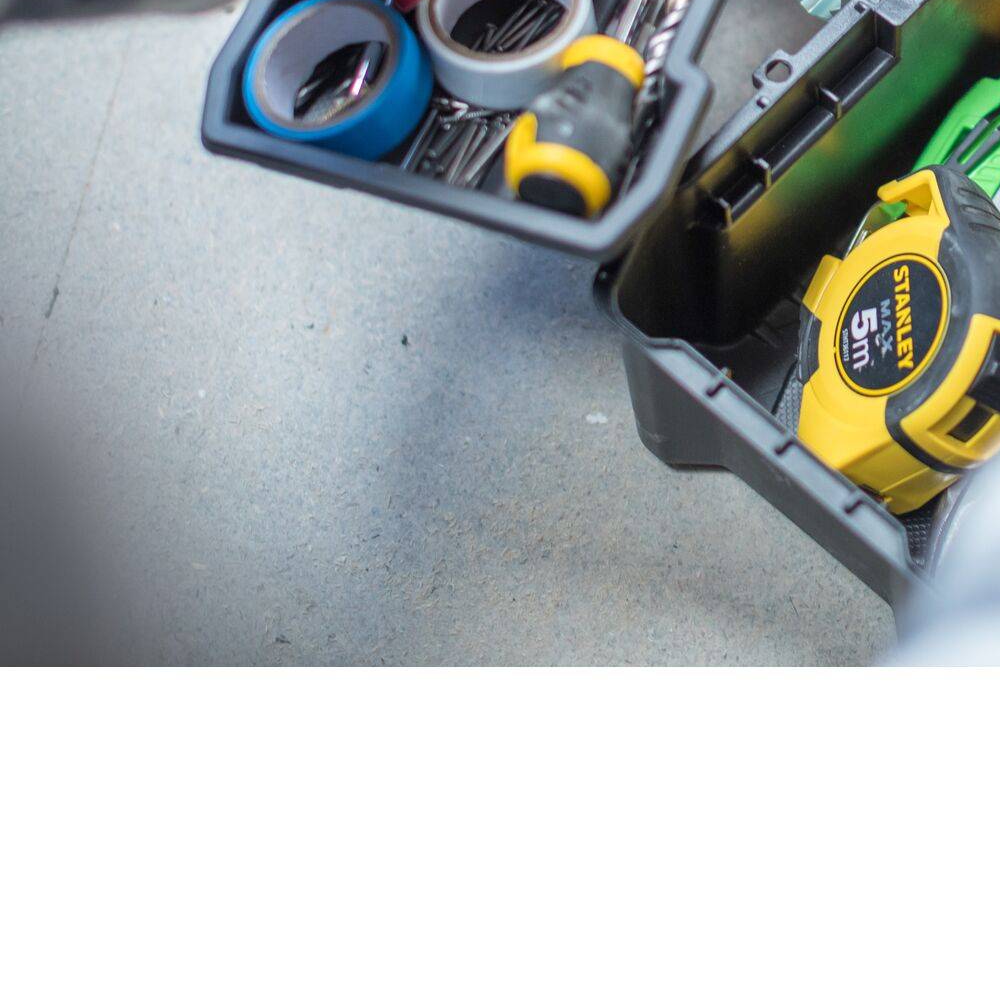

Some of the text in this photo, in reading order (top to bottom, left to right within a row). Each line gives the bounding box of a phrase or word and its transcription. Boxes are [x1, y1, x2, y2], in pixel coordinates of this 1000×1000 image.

[851, 307, 878, 369] 5m
[880, 298, 893, 355] MAX
[893, 264, 914, 370] STANLEY
